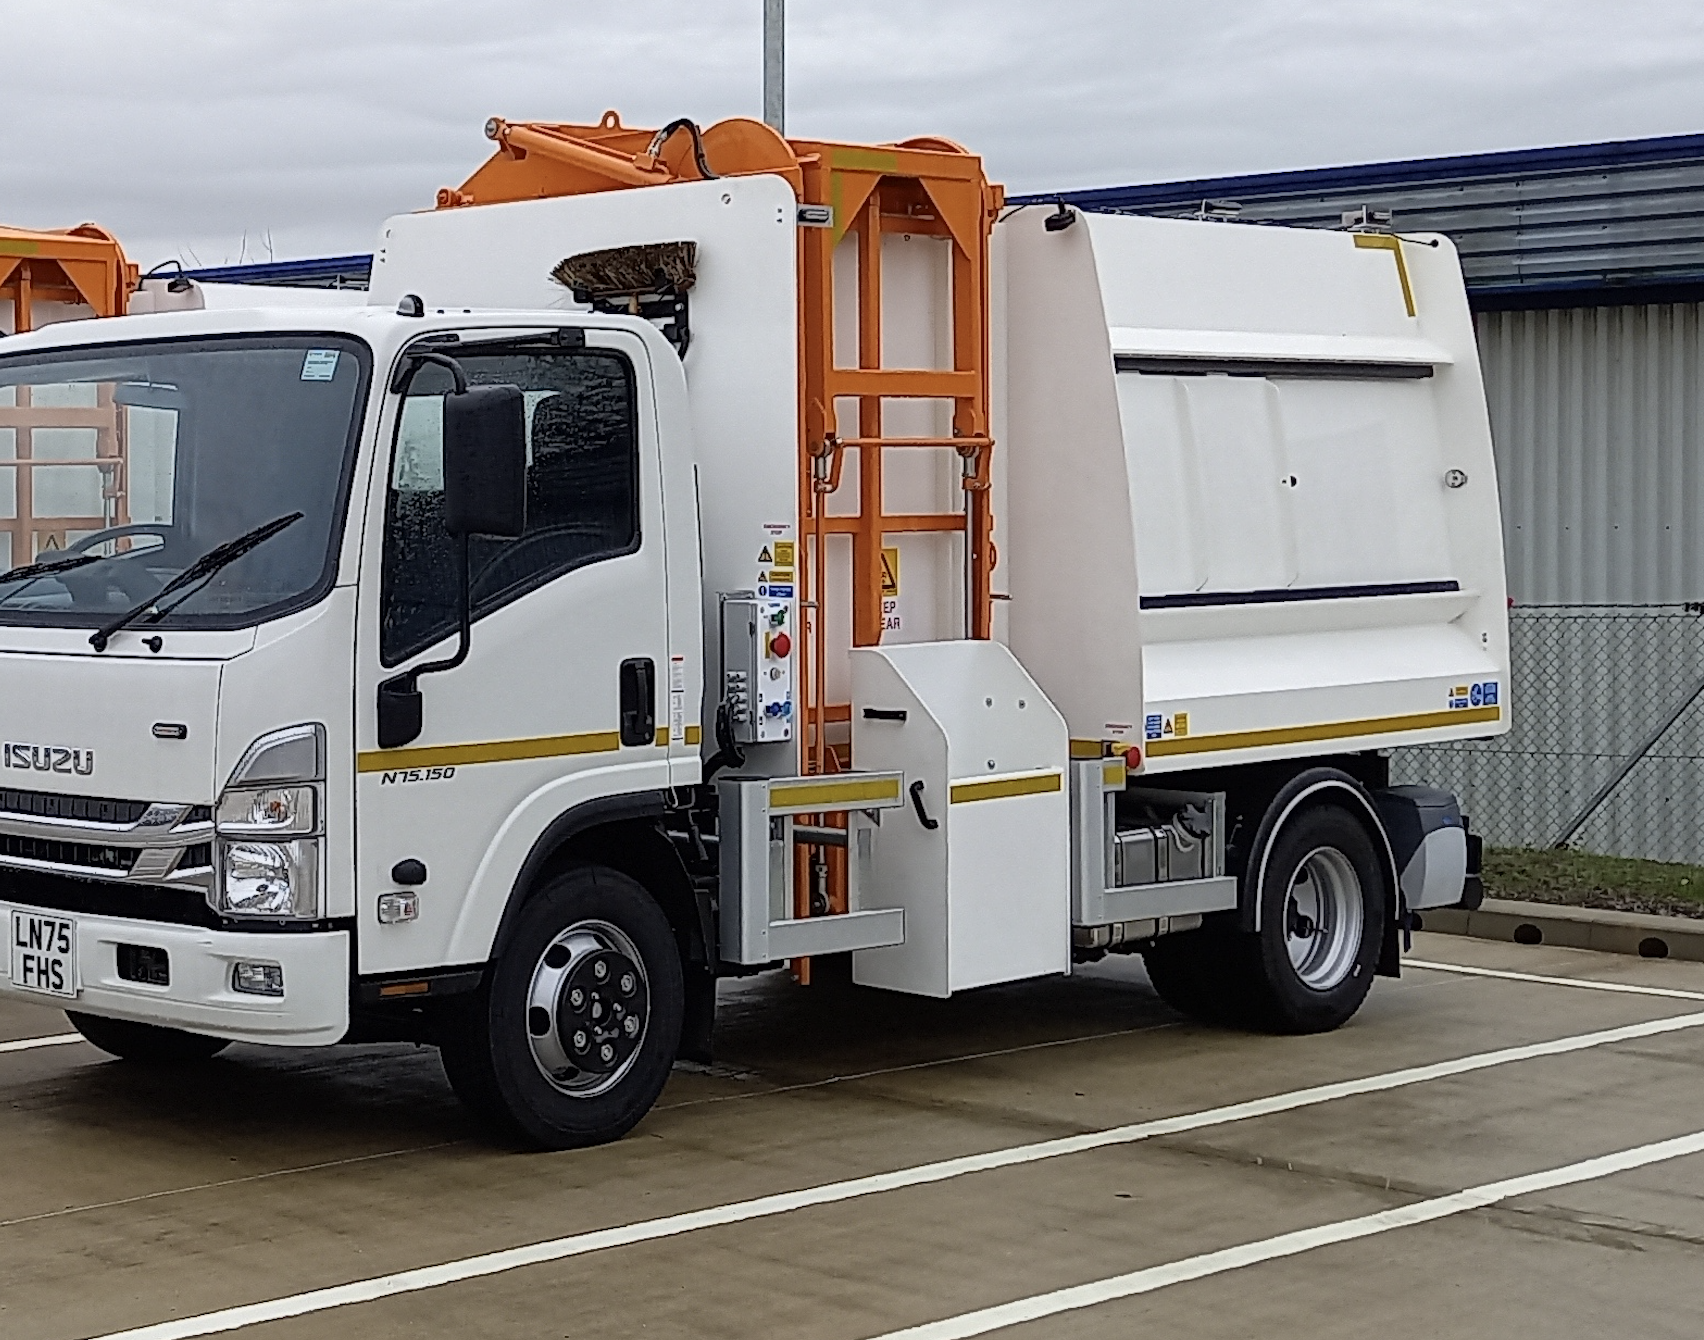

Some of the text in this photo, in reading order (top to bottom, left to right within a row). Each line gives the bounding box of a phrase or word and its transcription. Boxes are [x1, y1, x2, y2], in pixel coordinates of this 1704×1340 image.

[883, 600, 896, 613] EP
[880, 617, 900, 630] EAR
[3, 742, 94, 776] ISUZU
[381, 767, 456, 786] N75.150
[15, 915, 71, 954] LN75
[23, 953, 64, 990] FHS
